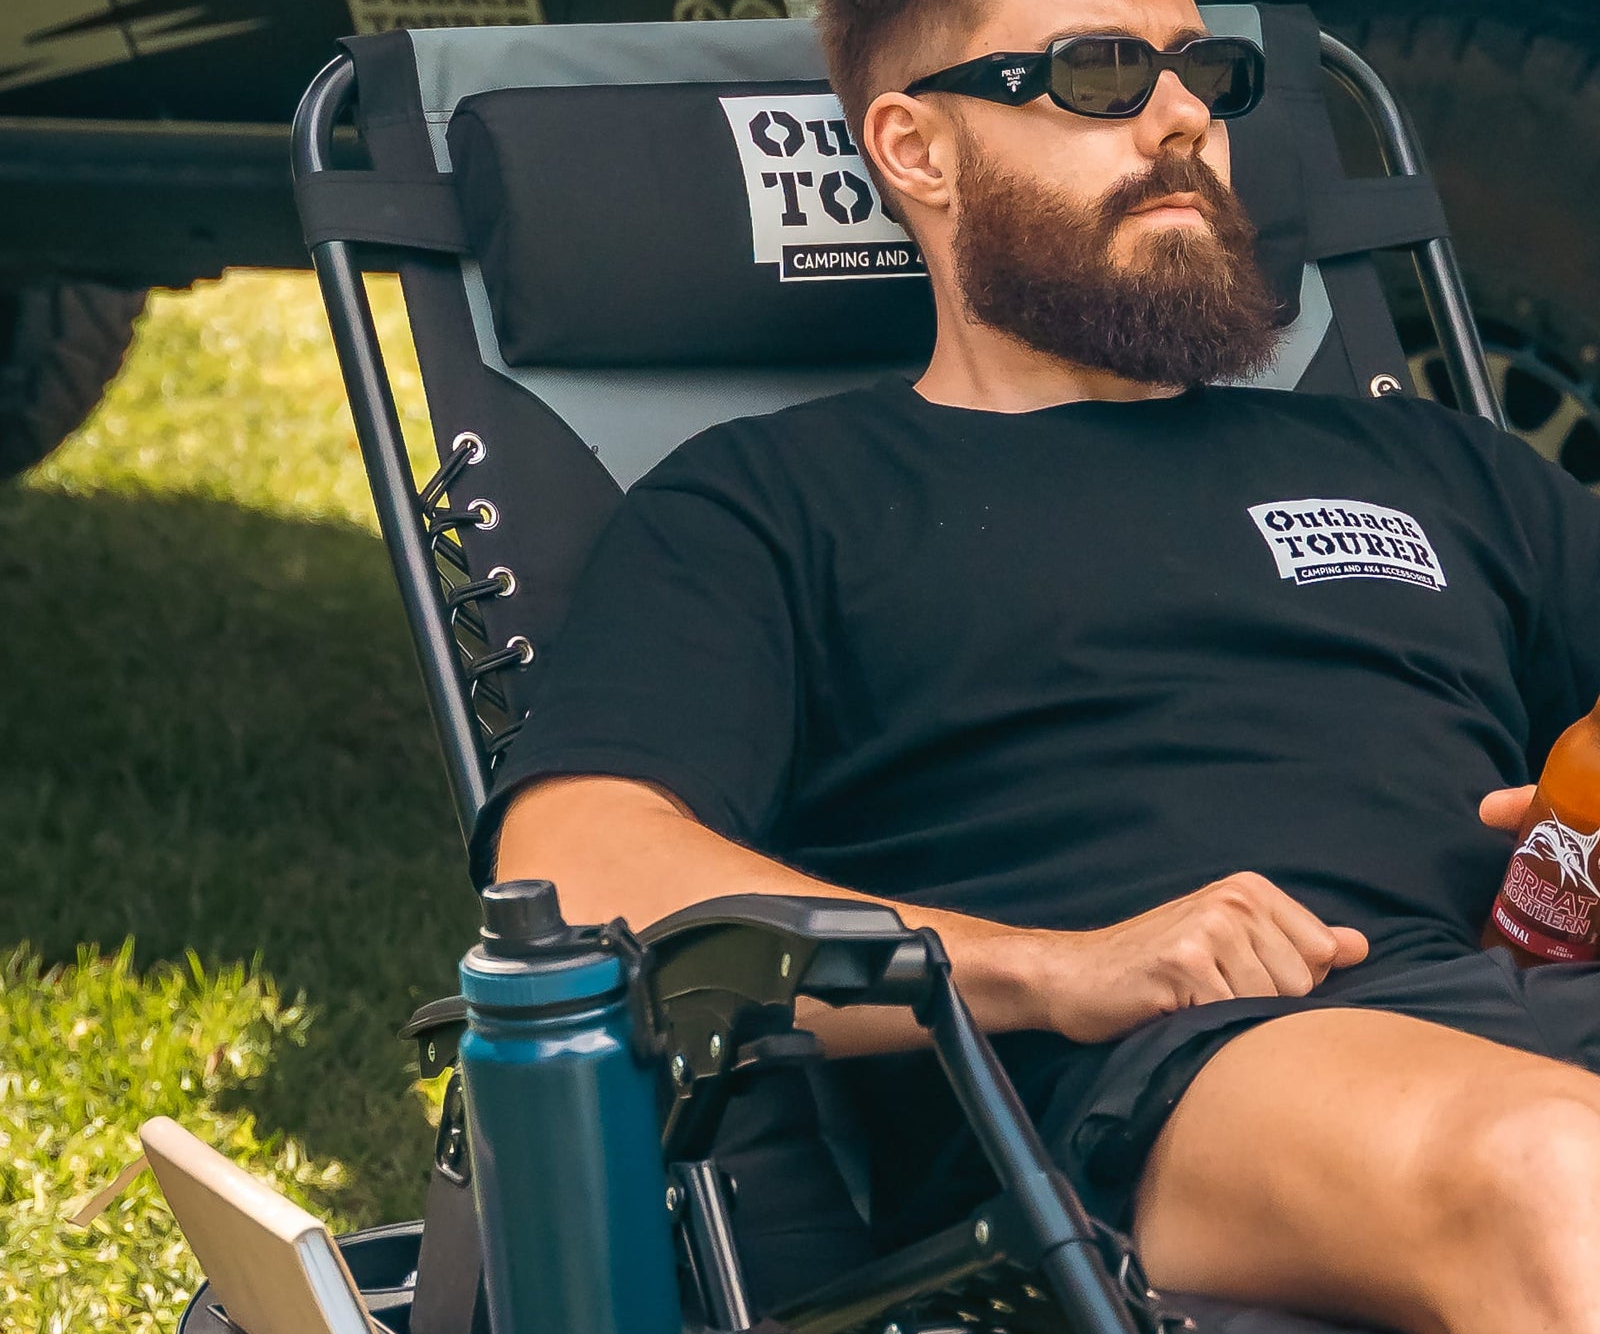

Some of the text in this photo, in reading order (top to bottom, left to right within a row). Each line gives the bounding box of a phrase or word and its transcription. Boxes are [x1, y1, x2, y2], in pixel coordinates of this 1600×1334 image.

[793, 251, 870, 269] CAMPING
[875, 249, 910, 267] AND
[1263, 507, 1421, 541] Outback
[1275, 531, 1435, 570] TOURER
[1301, 567, 1342, 579] CAMPING
[1343, 564, 1362, 574] AND
[1363, 565, 1381, 574] 4X4
[1503, 874, 1591, 936] NORTHERN
[1510, 855, 1599, 920] GREAT
